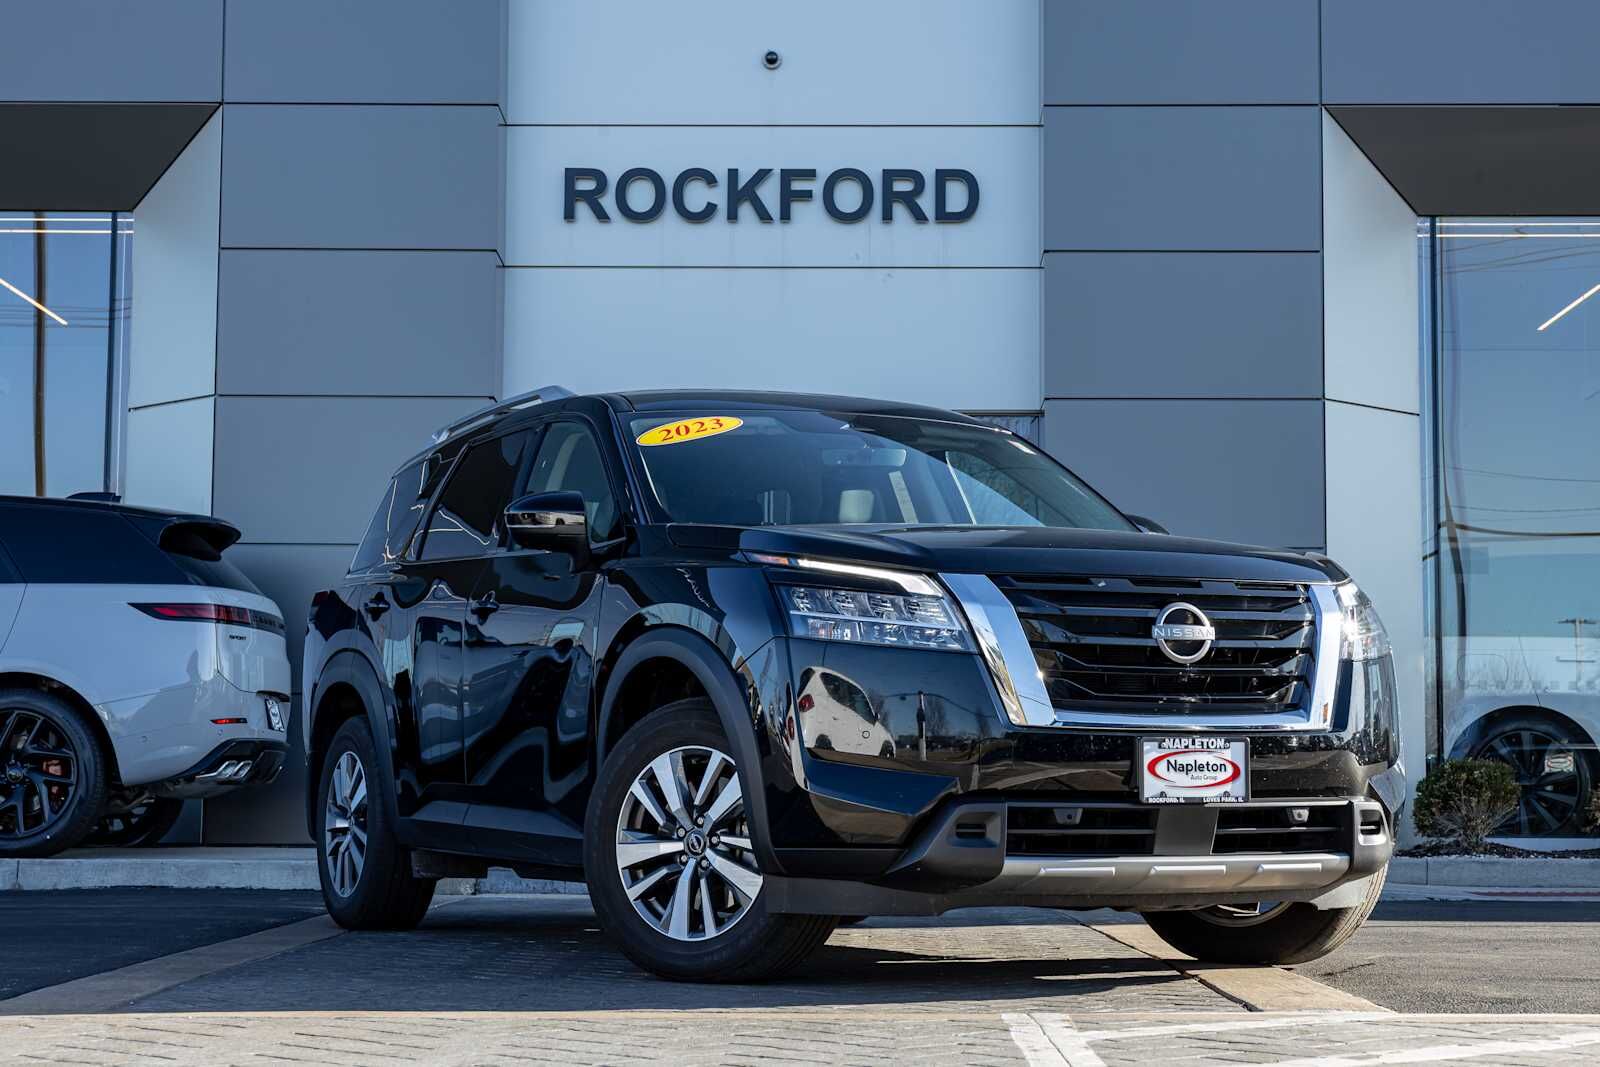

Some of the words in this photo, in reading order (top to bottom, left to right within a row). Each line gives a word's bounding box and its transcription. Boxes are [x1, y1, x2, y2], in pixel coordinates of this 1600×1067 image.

[563, 167, 980, 223] ROCKFORD
[659, 418, 723, 441] 2023
[1154, 628, 1214, 637] NISSAN
[1165, 738, 1225, 749] NAPLETON
[1166, 759, 1227, 775] Napleton
